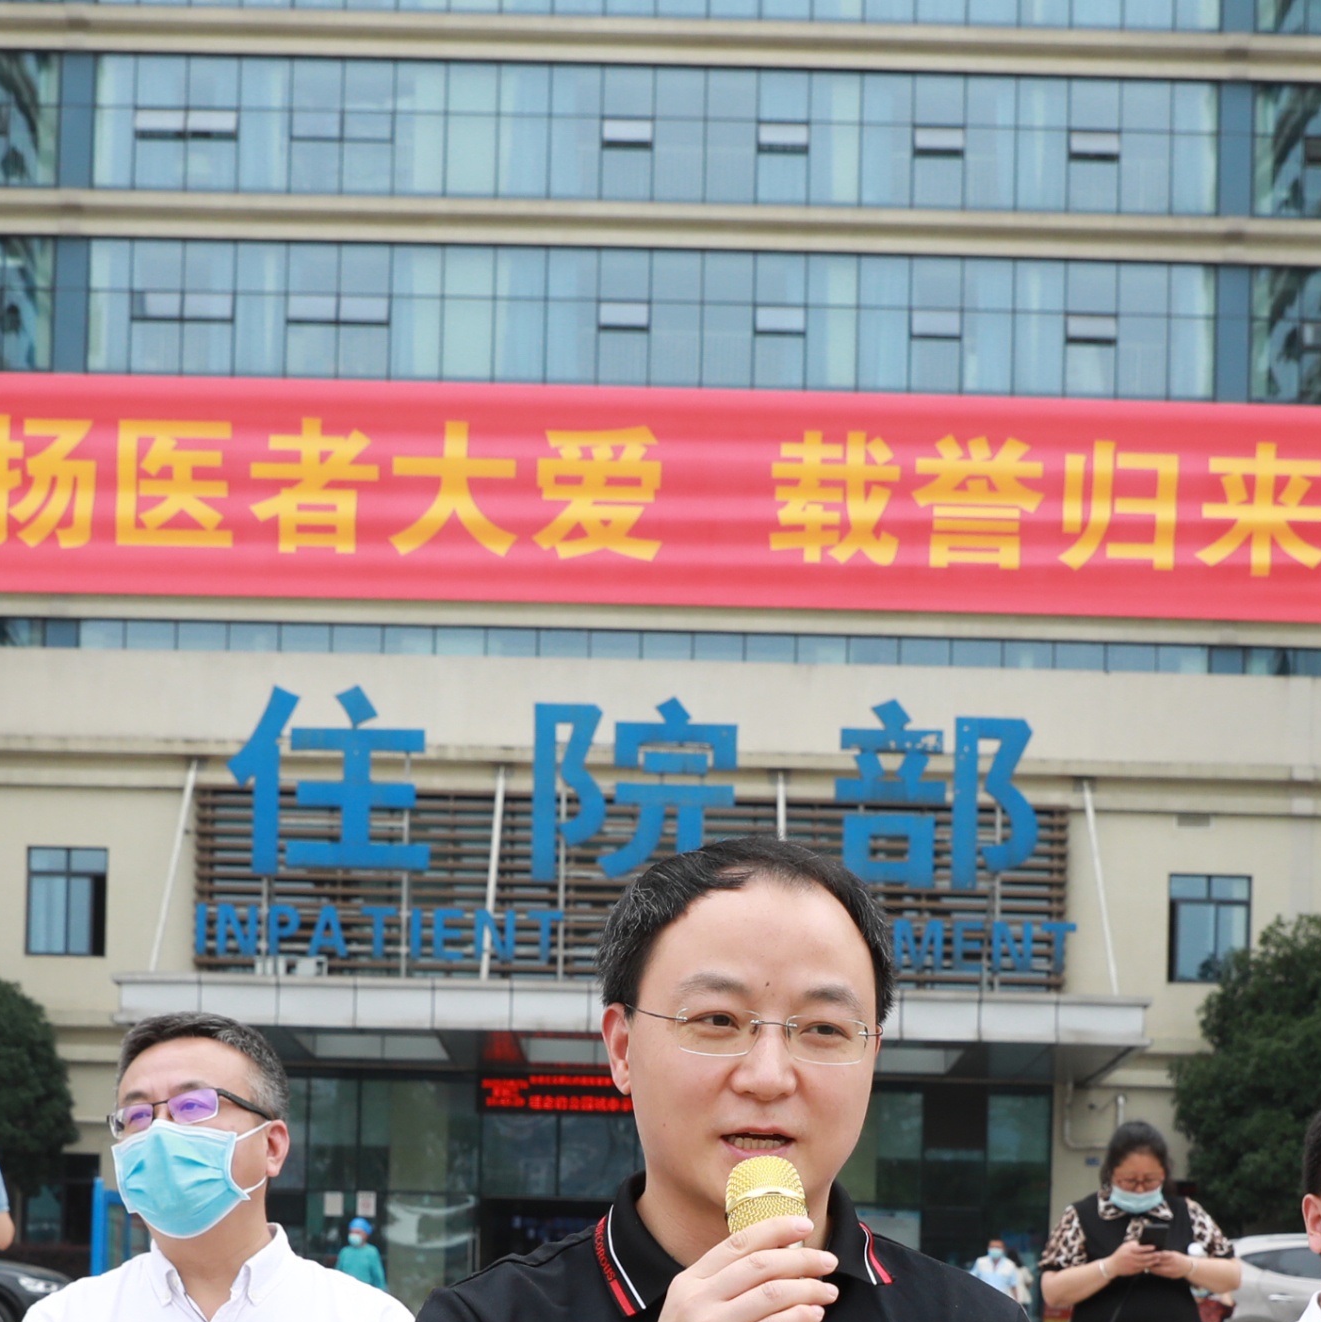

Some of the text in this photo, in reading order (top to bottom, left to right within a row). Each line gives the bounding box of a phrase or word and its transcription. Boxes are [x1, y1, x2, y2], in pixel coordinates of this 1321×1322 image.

[226, 685, 1040, 890] 住院部
[194, 902, 1078, 975] INPATIENT MENT
